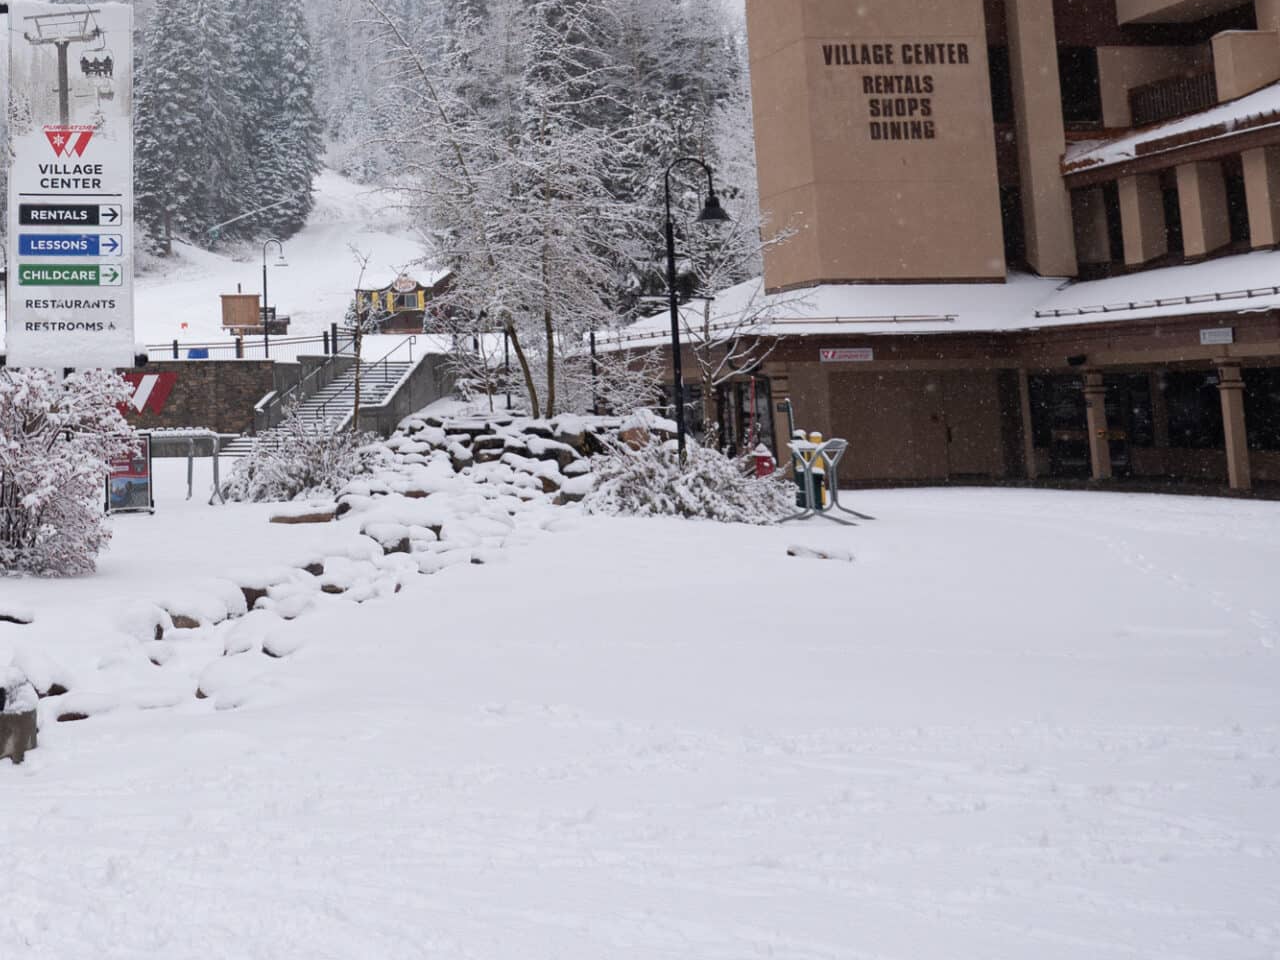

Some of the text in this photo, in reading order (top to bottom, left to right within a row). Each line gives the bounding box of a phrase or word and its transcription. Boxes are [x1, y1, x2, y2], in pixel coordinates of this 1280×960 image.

[822, 43, 969, 66] VILLAGE CENTER
[862, 75, 934, 94] RENTALS
[869, 98, 931, 117] SHOPS
[870, 121, 935, 140] DINING
[38, 164, 103, 175] VILLAGE
[40, 177, 101, 189] CENTER
[30, 210, 88, 220] RENTALS
[30, 240, 88, 250] LESSONS
[22, 270, 96, 281] CHILDCARE
[25, 299, 116, 309] RESTAURANTS
[25, 321, 103, 331] RESTROOMS
